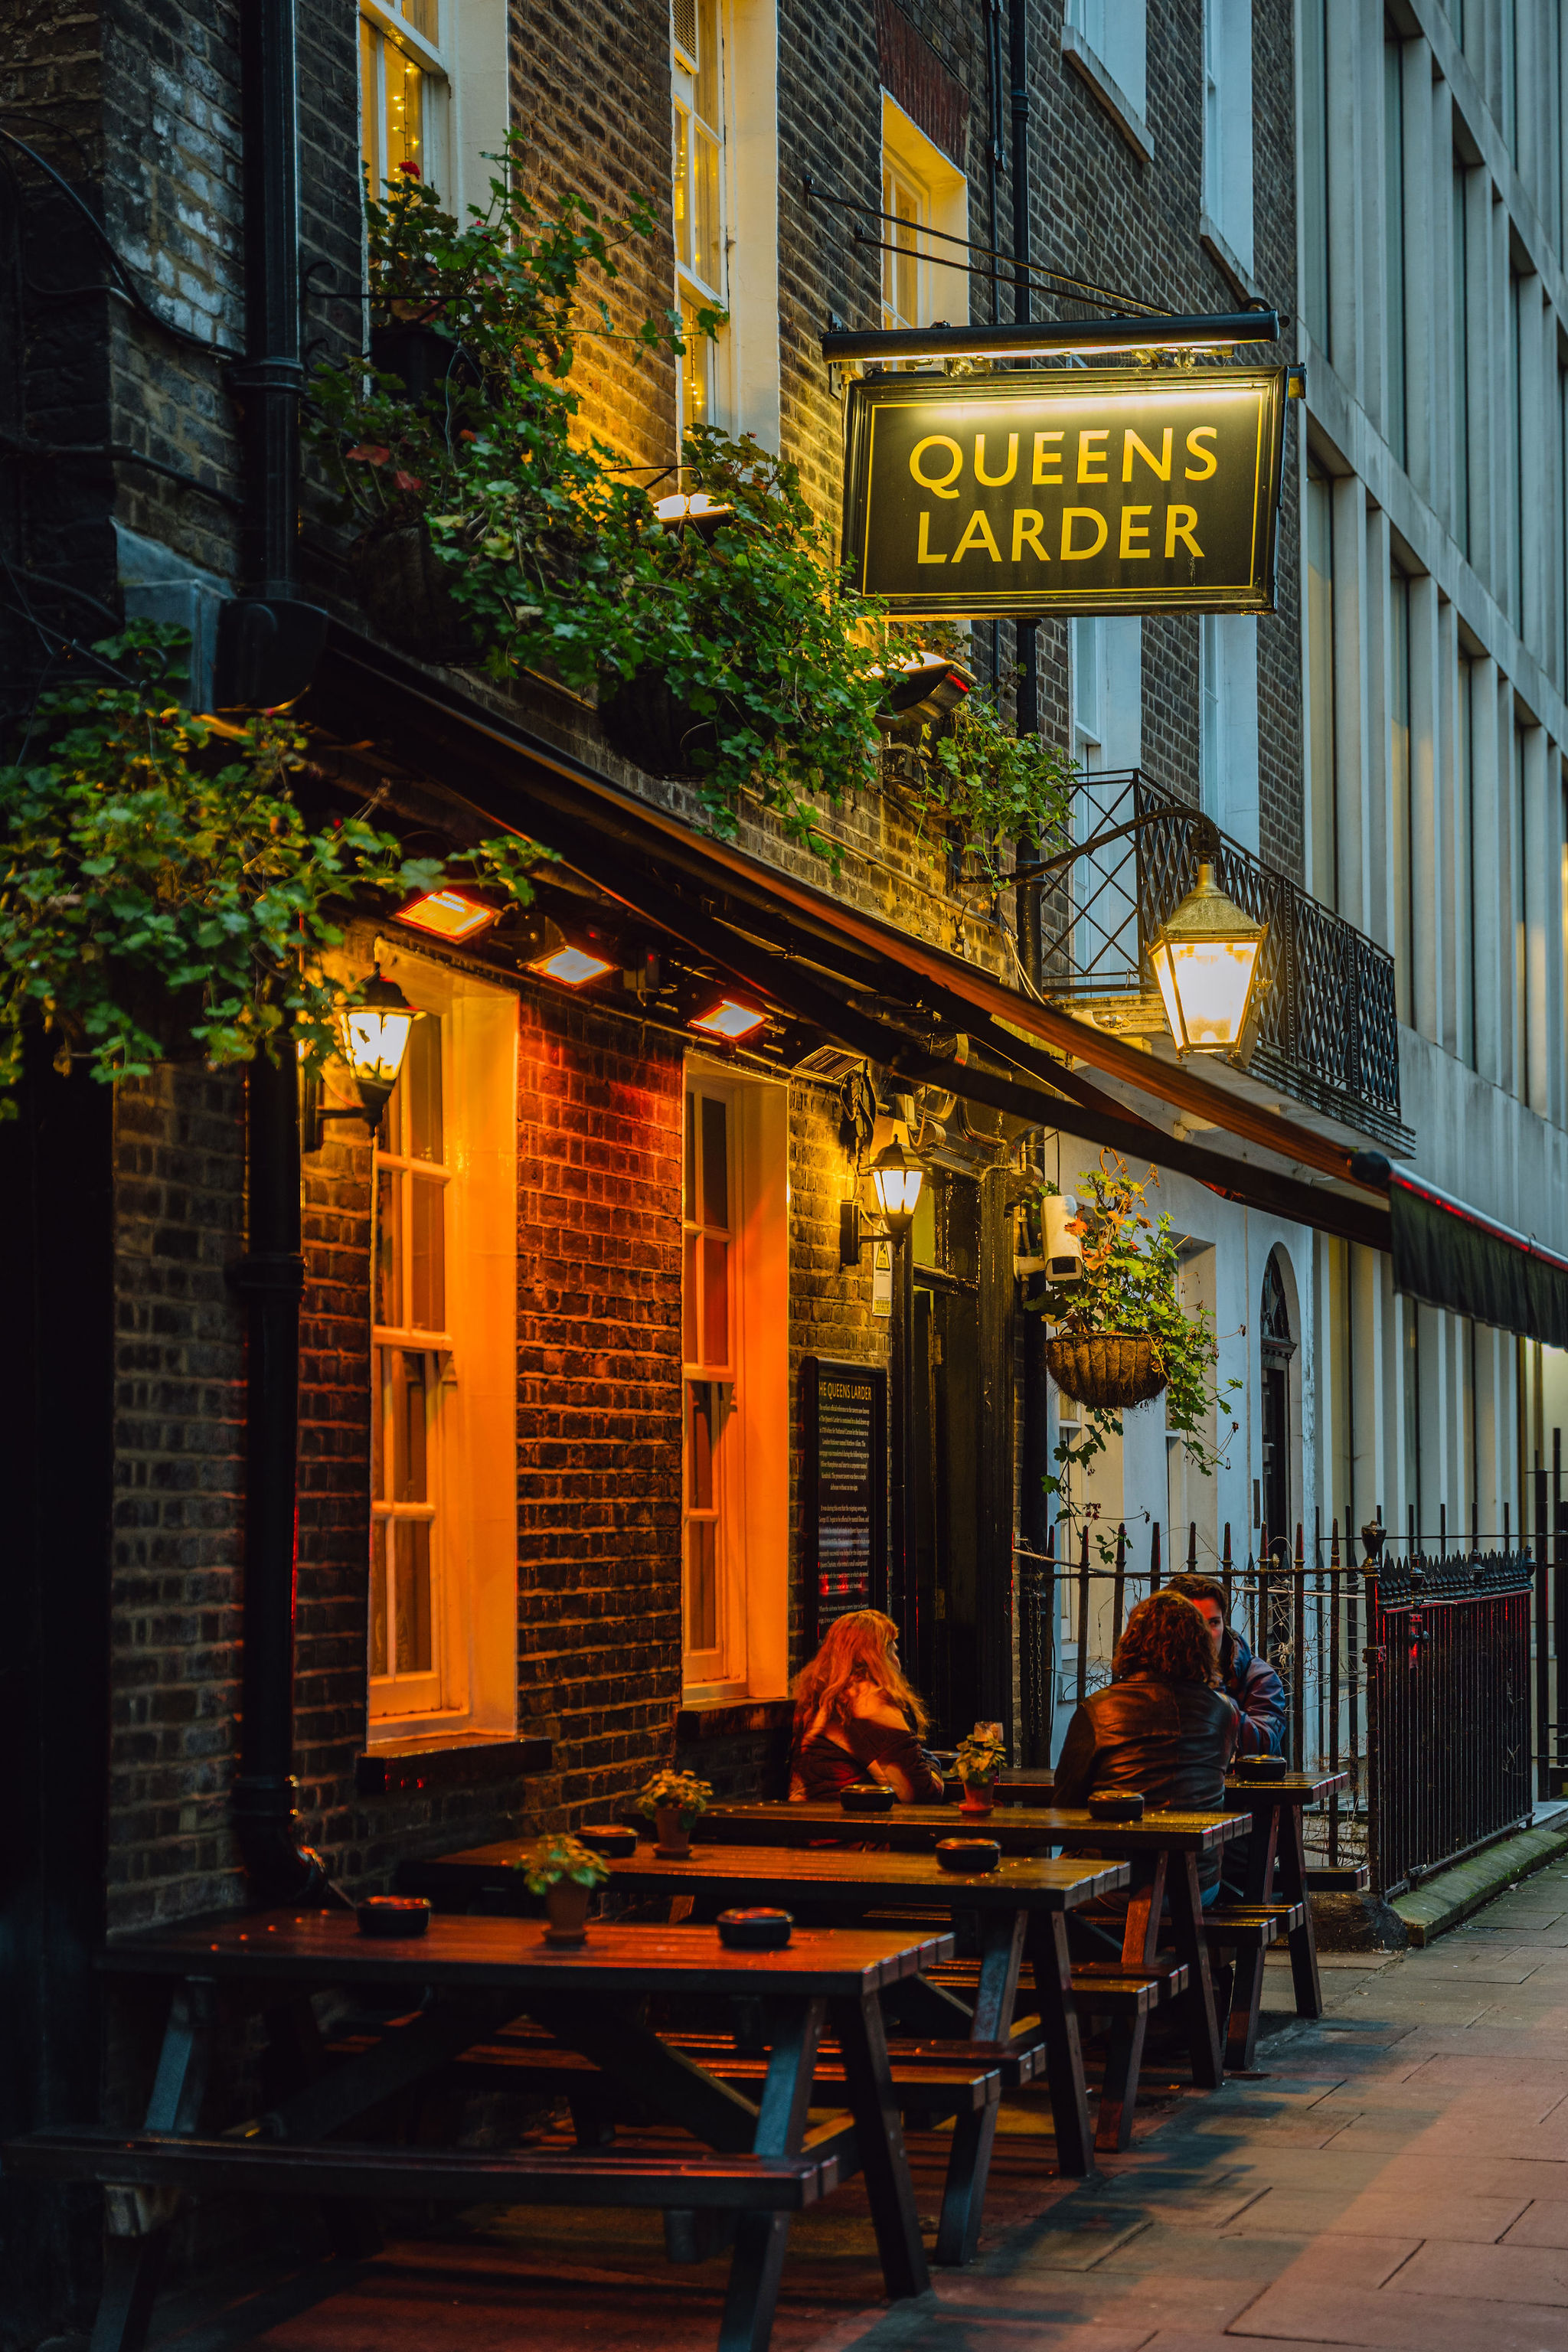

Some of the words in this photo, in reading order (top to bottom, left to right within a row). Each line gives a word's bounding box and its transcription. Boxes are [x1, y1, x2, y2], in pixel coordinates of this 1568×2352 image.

[909, 426, 1218, 499] QUEENS
[917, 504, 1205, 564] LARDER
[818, 1381, 827, 1396] HE
[828, 1382, 851, 1400] QUEENS
[851, 1384, 872, 1401] LARDER
